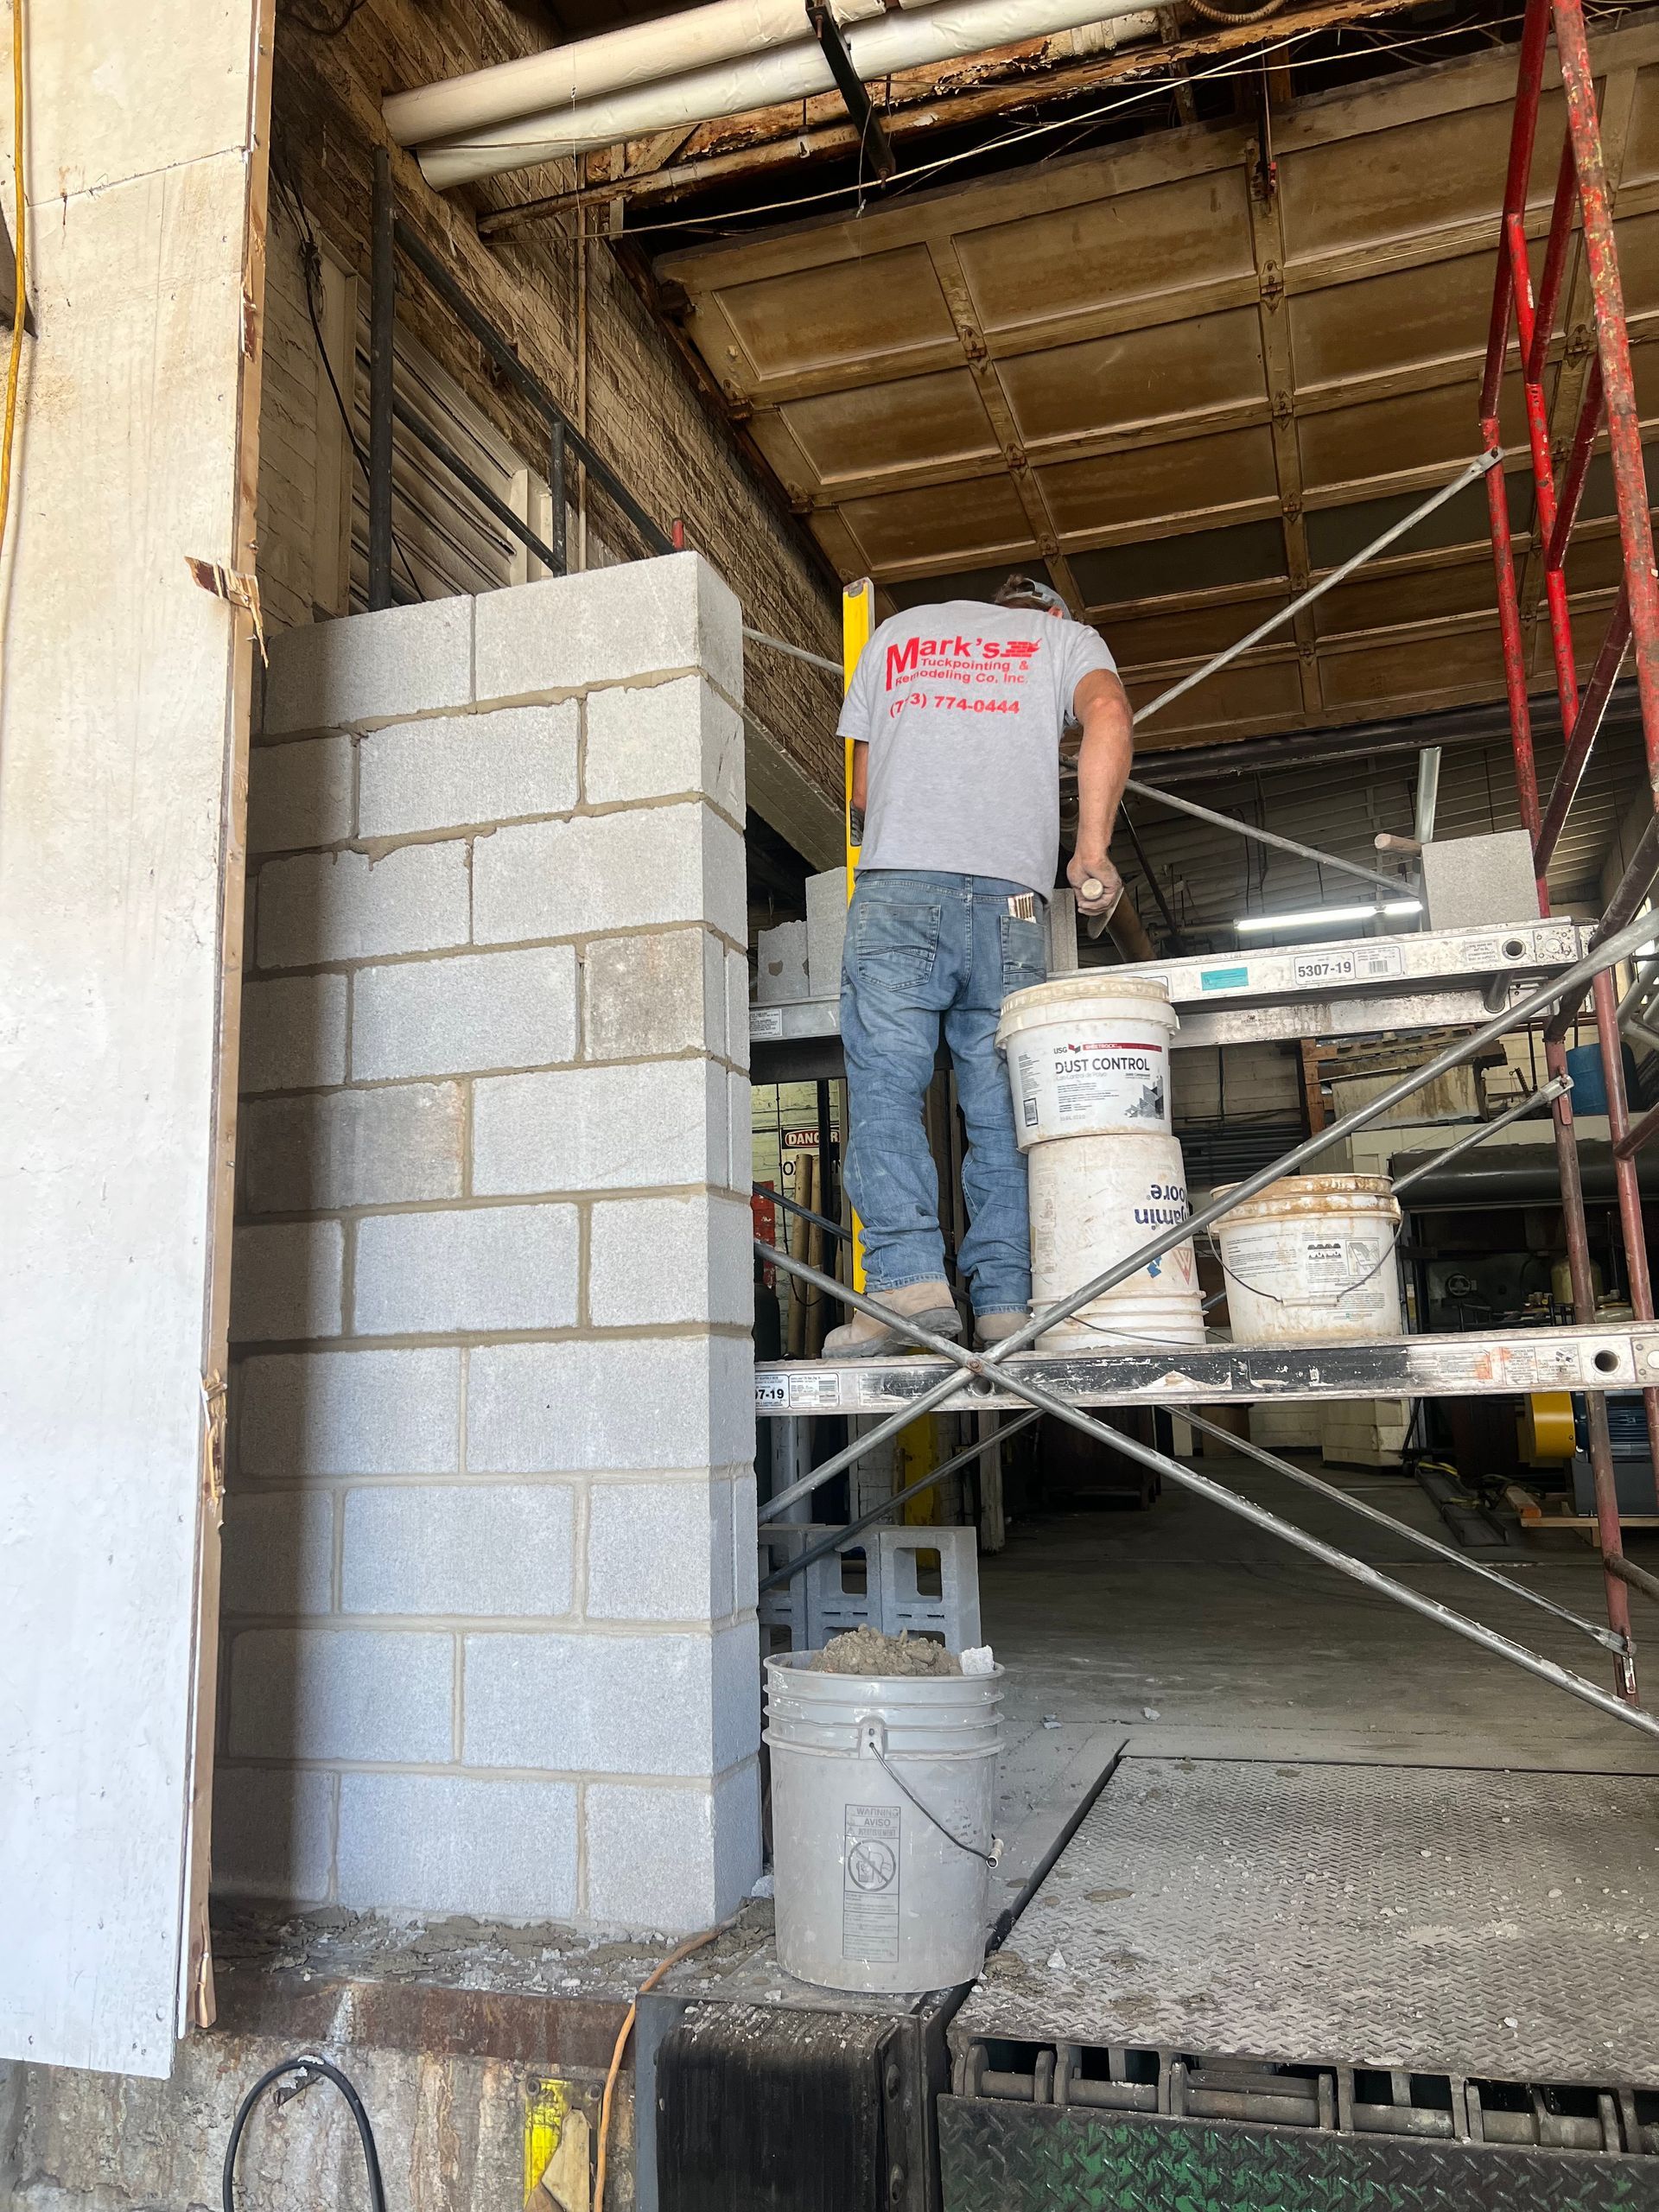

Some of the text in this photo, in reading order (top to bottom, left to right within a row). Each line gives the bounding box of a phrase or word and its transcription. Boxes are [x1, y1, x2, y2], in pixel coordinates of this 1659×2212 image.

[886, 637, 1000, 691] Mark's
[921, 658, 1029, 672] Tuckpointing &
[895, 669, 970, 687] Remodeling
[934, 696, 1020, 715] 774-0444
[1298, 962, 1351, 977] 5307-19
[1055, 1058, 1150, 1074] DUST CONTROL
[788, 1132, 838, 1145] DANGR
[1150, 1185, 1187, 1204] oore
[864, 1817, 891, 1827] AVISO
